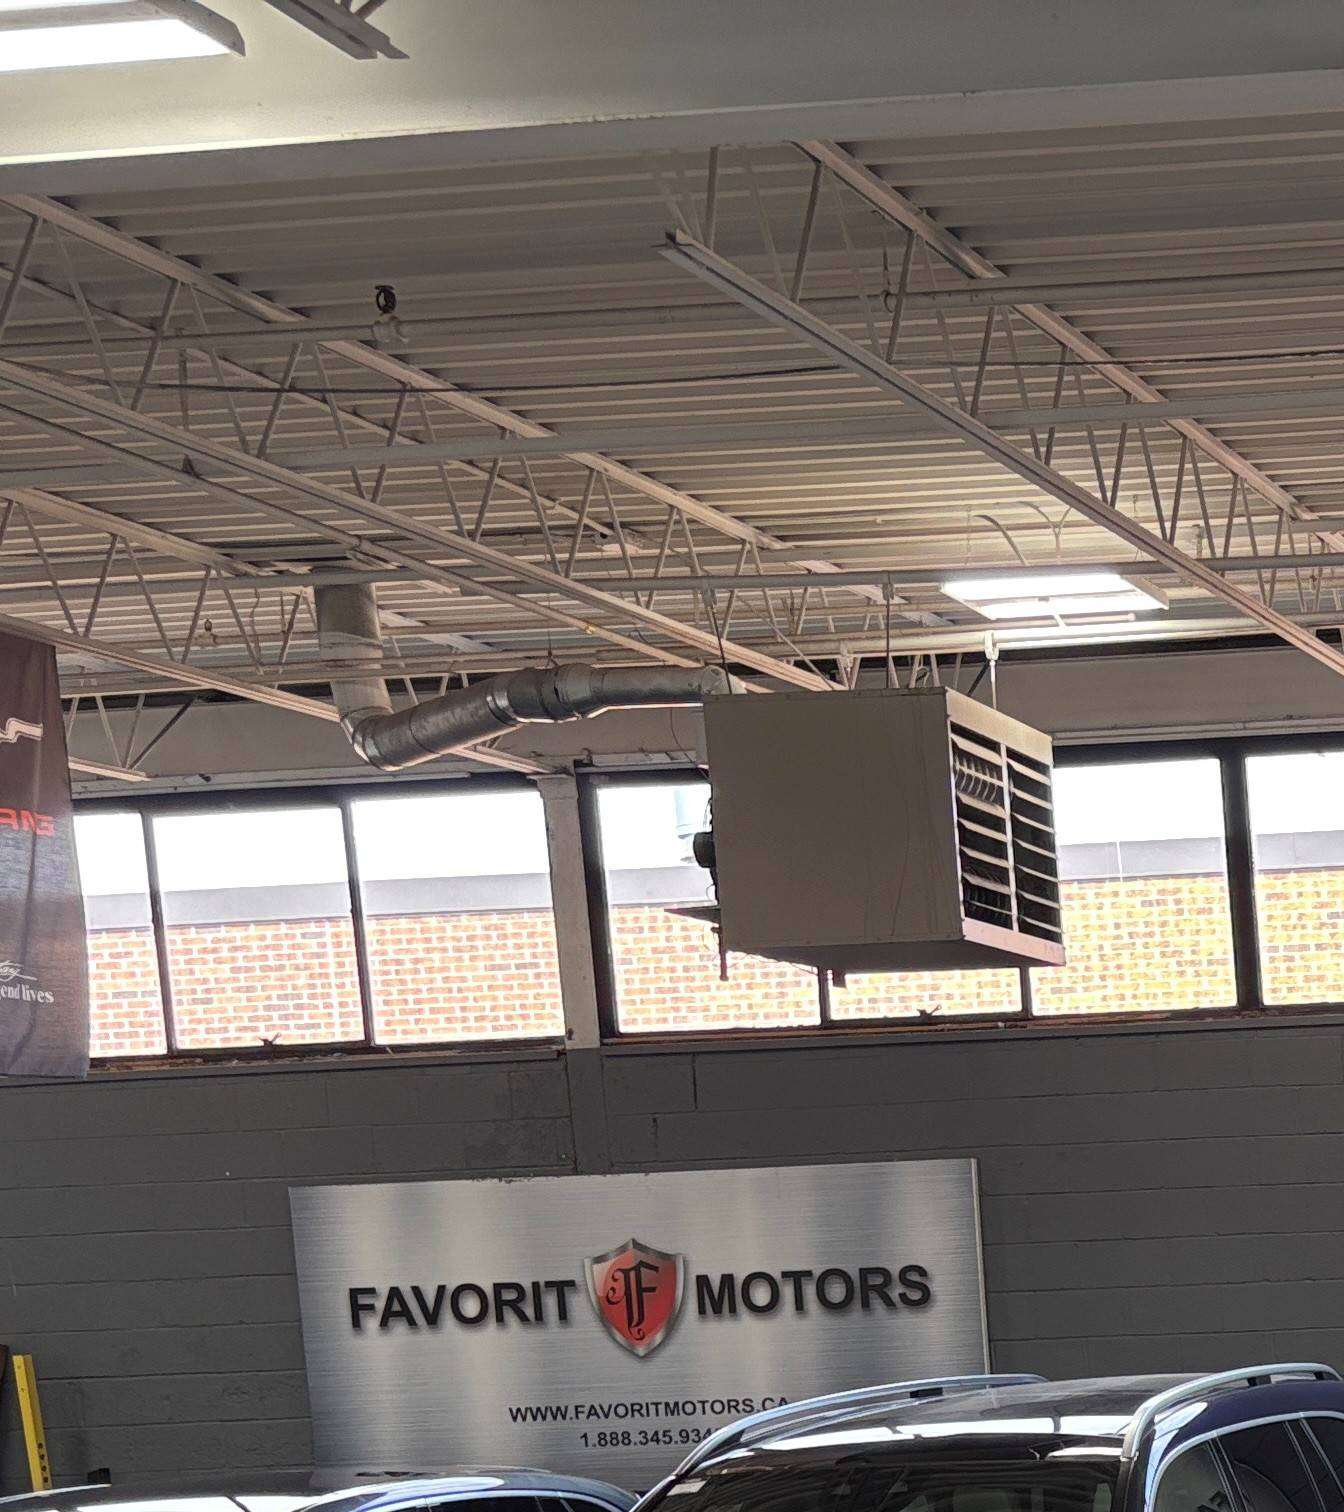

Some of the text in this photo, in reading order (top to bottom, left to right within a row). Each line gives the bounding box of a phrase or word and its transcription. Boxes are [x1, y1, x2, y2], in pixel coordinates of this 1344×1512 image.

[0, 984, 55, 1003] end lives
[348, 1279, 576, 1329] FAVORIT
[695, 1264, 932, 1316] MOTORS
[580, 1427, 722, 1448] 1.888.345.934
